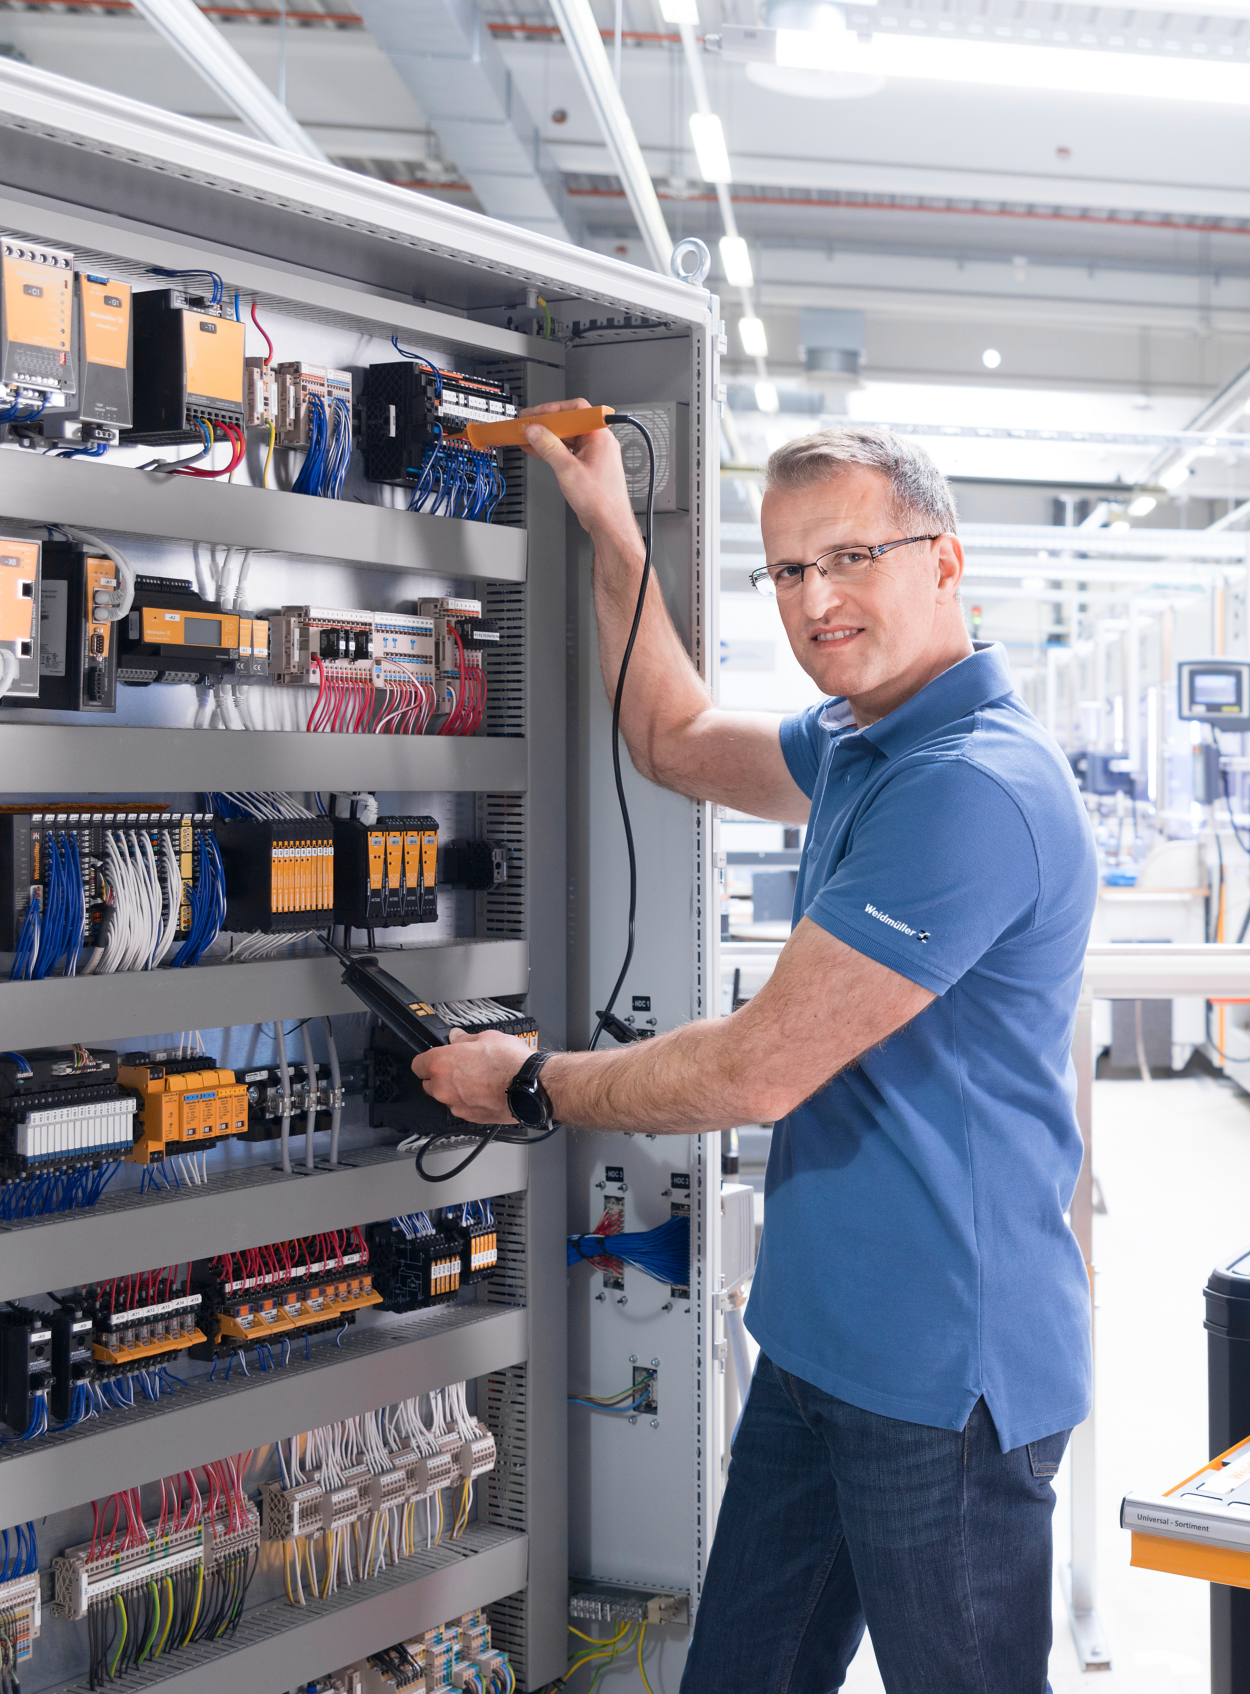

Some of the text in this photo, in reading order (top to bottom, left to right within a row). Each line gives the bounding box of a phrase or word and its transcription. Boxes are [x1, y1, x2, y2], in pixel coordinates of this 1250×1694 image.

[865, 903, 917, 936] Weidmüller
[1136, 1513, 1169, 1526] Universal
[1174, 1519, 1210, 1533] Sortiment
